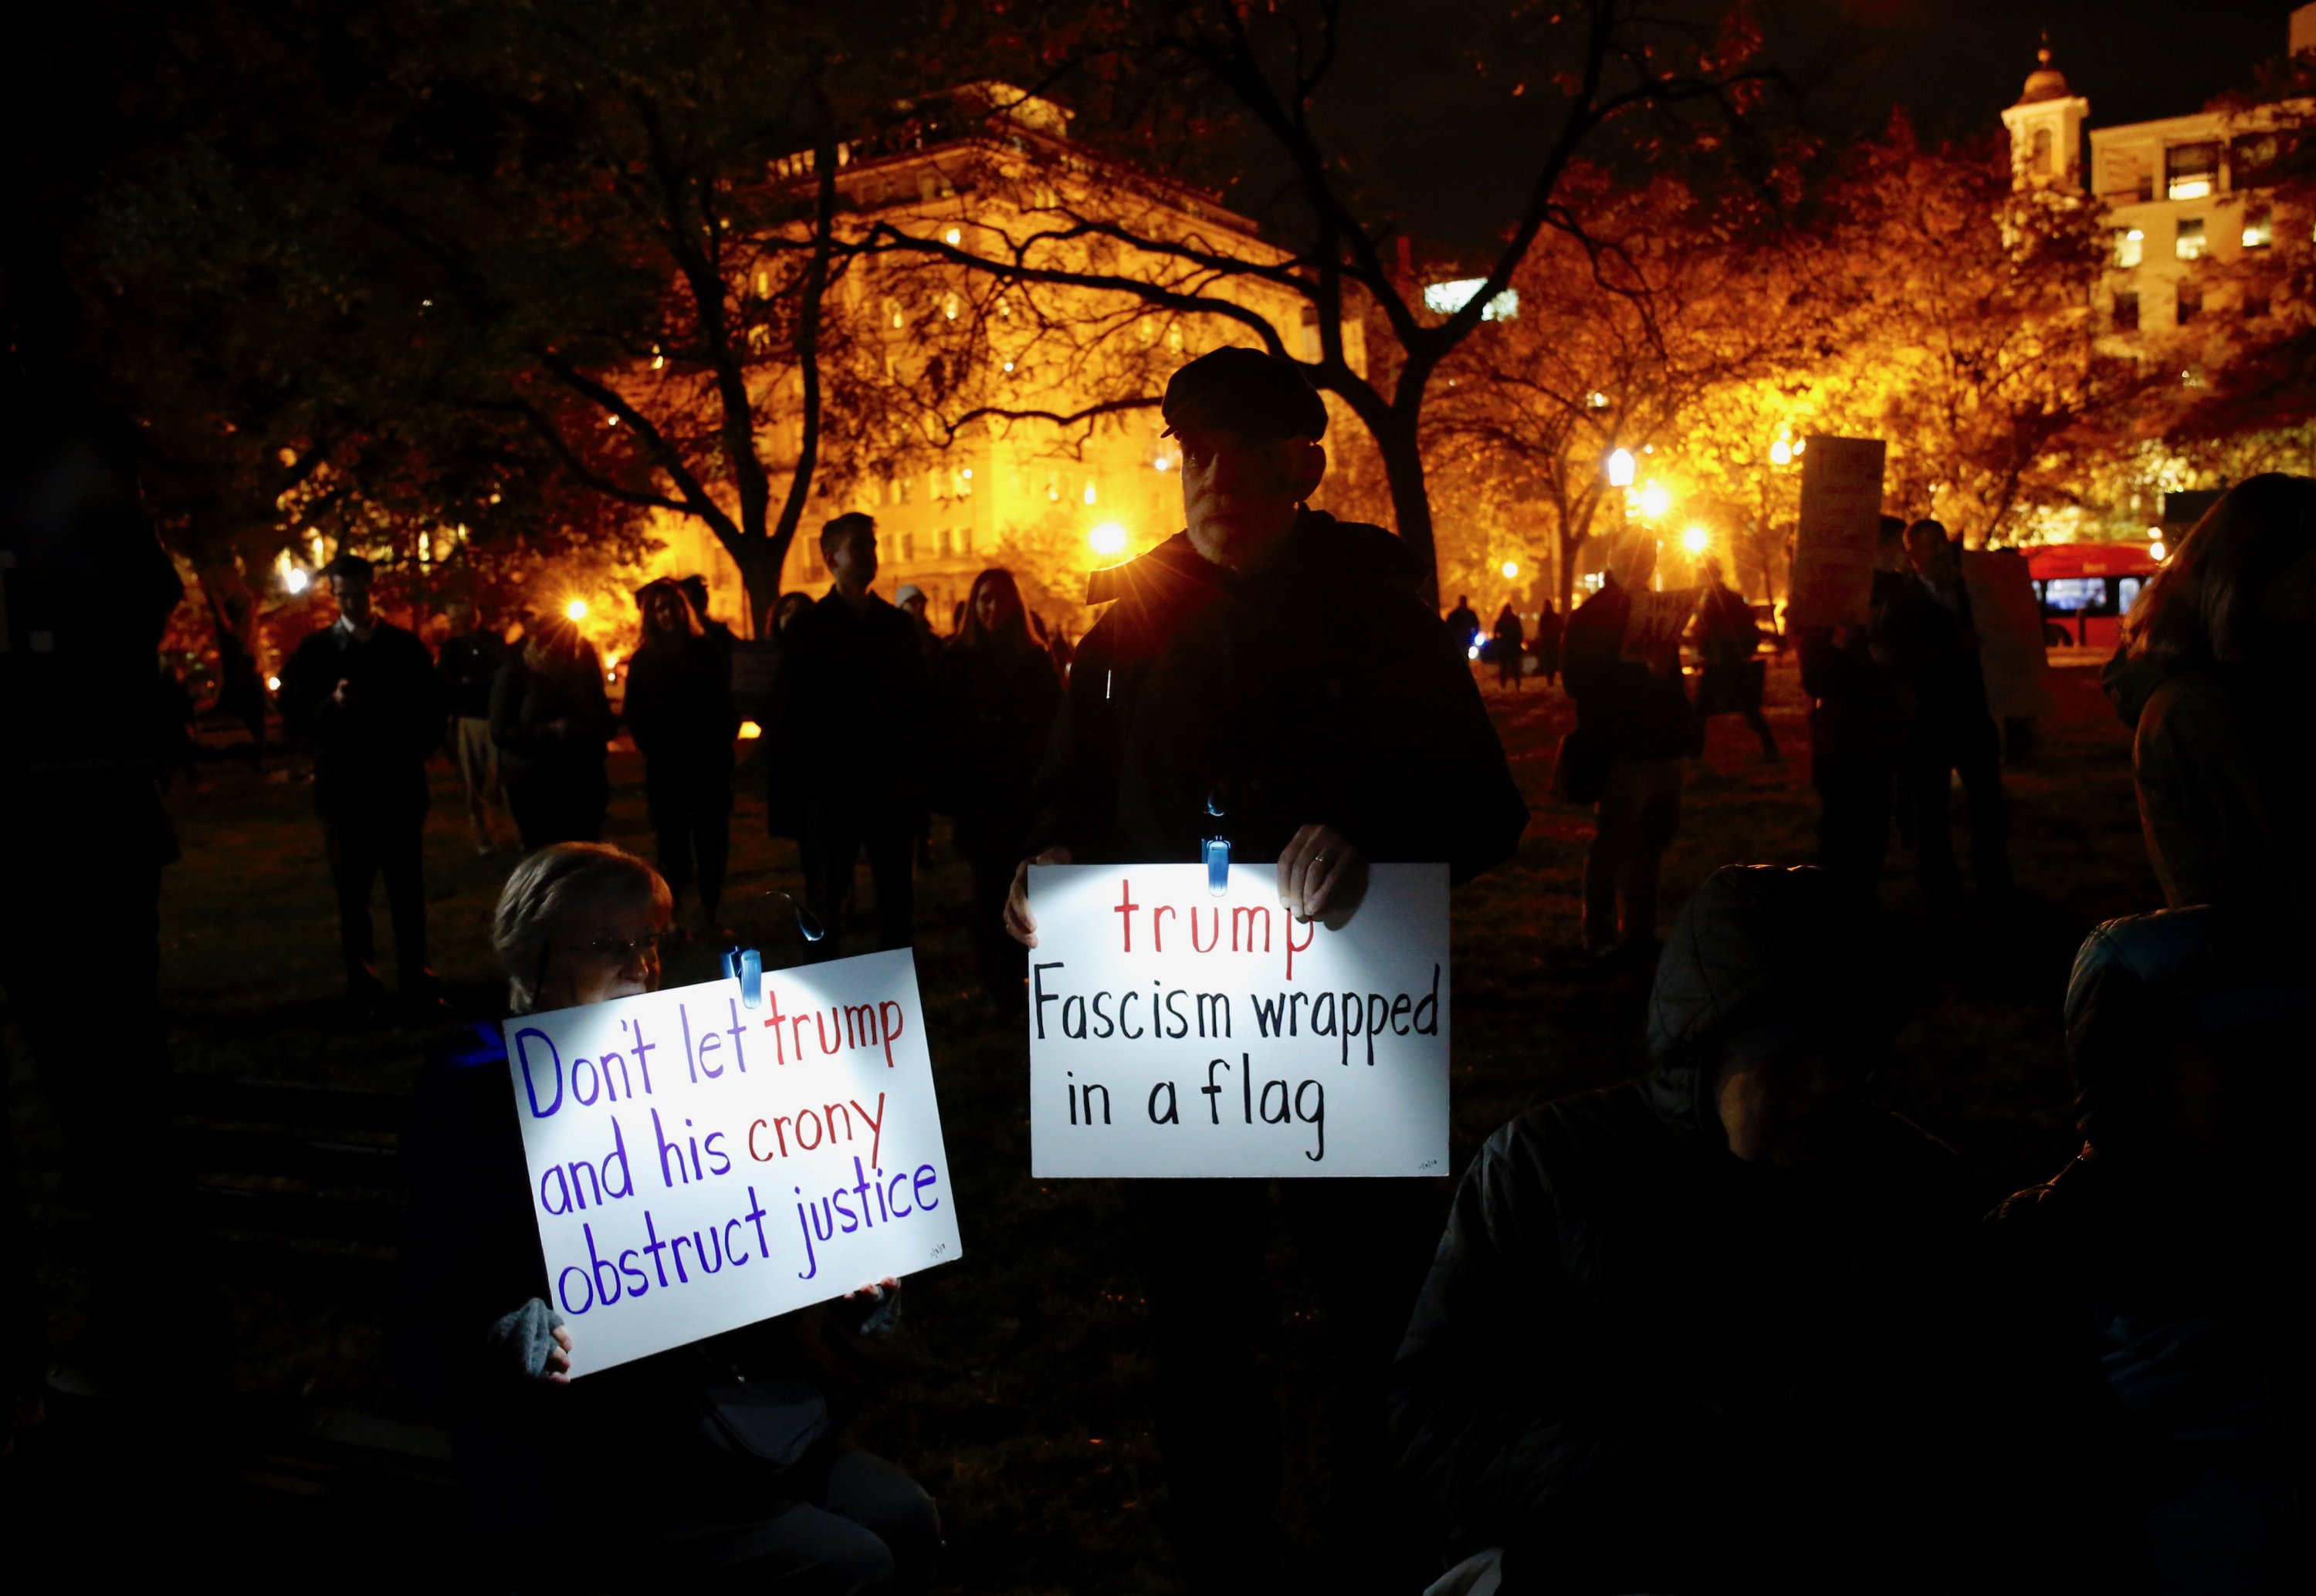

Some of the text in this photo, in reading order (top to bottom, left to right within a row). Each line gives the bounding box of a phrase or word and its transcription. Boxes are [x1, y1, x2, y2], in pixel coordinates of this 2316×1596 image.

[1114, 878, 1314, 980] trump
[514, 990, 904, 1119] Don't let trump
[1033, 962, 1441, 1066] Fascism wrapped
[540, 1092, 885, 1216] and his crony
[1067, 1053, 1325, 1161] in a flag
[558, 1156, 940, 1315] obstruct justice
